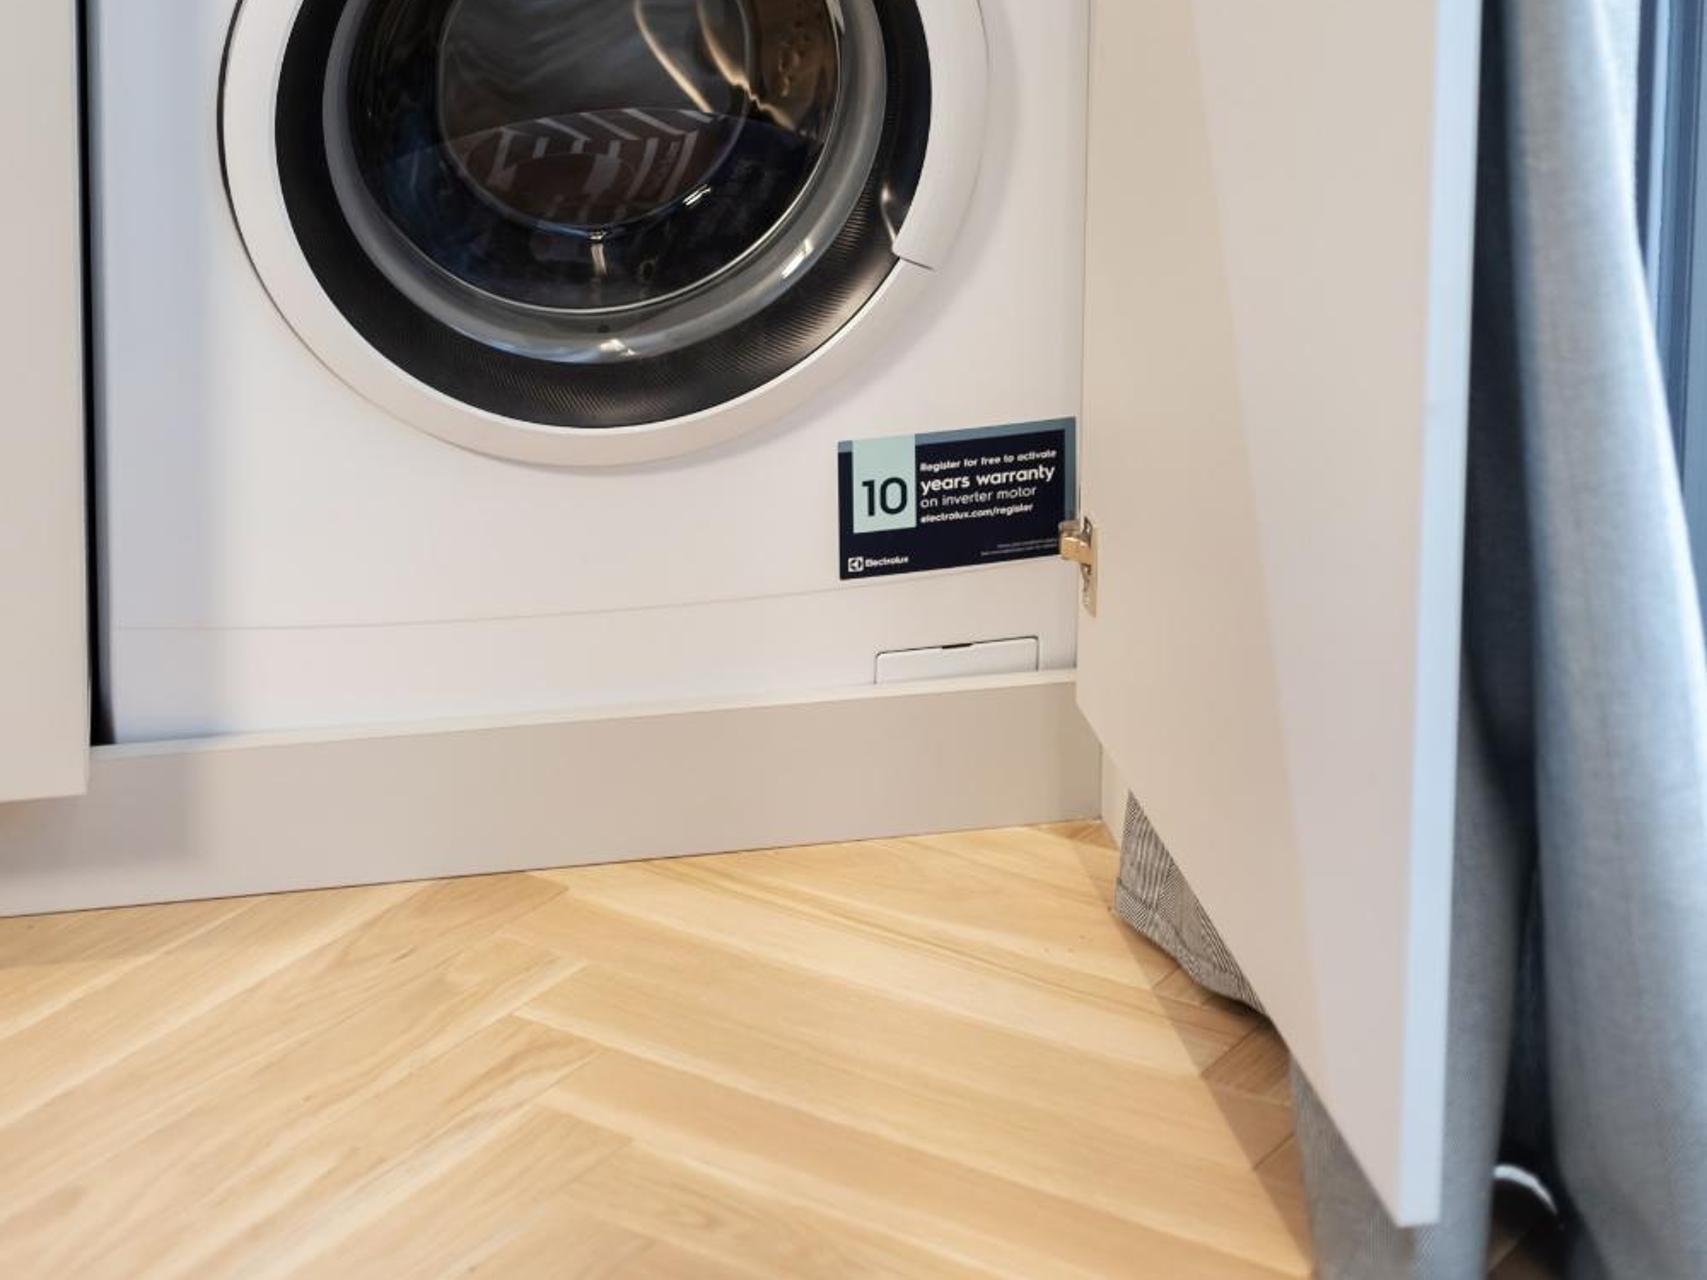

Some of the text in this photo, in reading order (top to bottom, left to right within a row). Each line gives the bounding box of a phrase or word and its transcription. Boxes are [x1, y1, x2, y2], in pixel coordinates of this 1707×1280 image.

[920, 449, 1057, 473] Register for free to activate
[920, 463, 1055, 496] years warranty
[862, 477, 908, 517] 10
[920, 486, 1037, 508] on inverter motor
[920, 503, 1034, 524] electrolux.com/register
[865, 556, 909, 567] Electrolux
